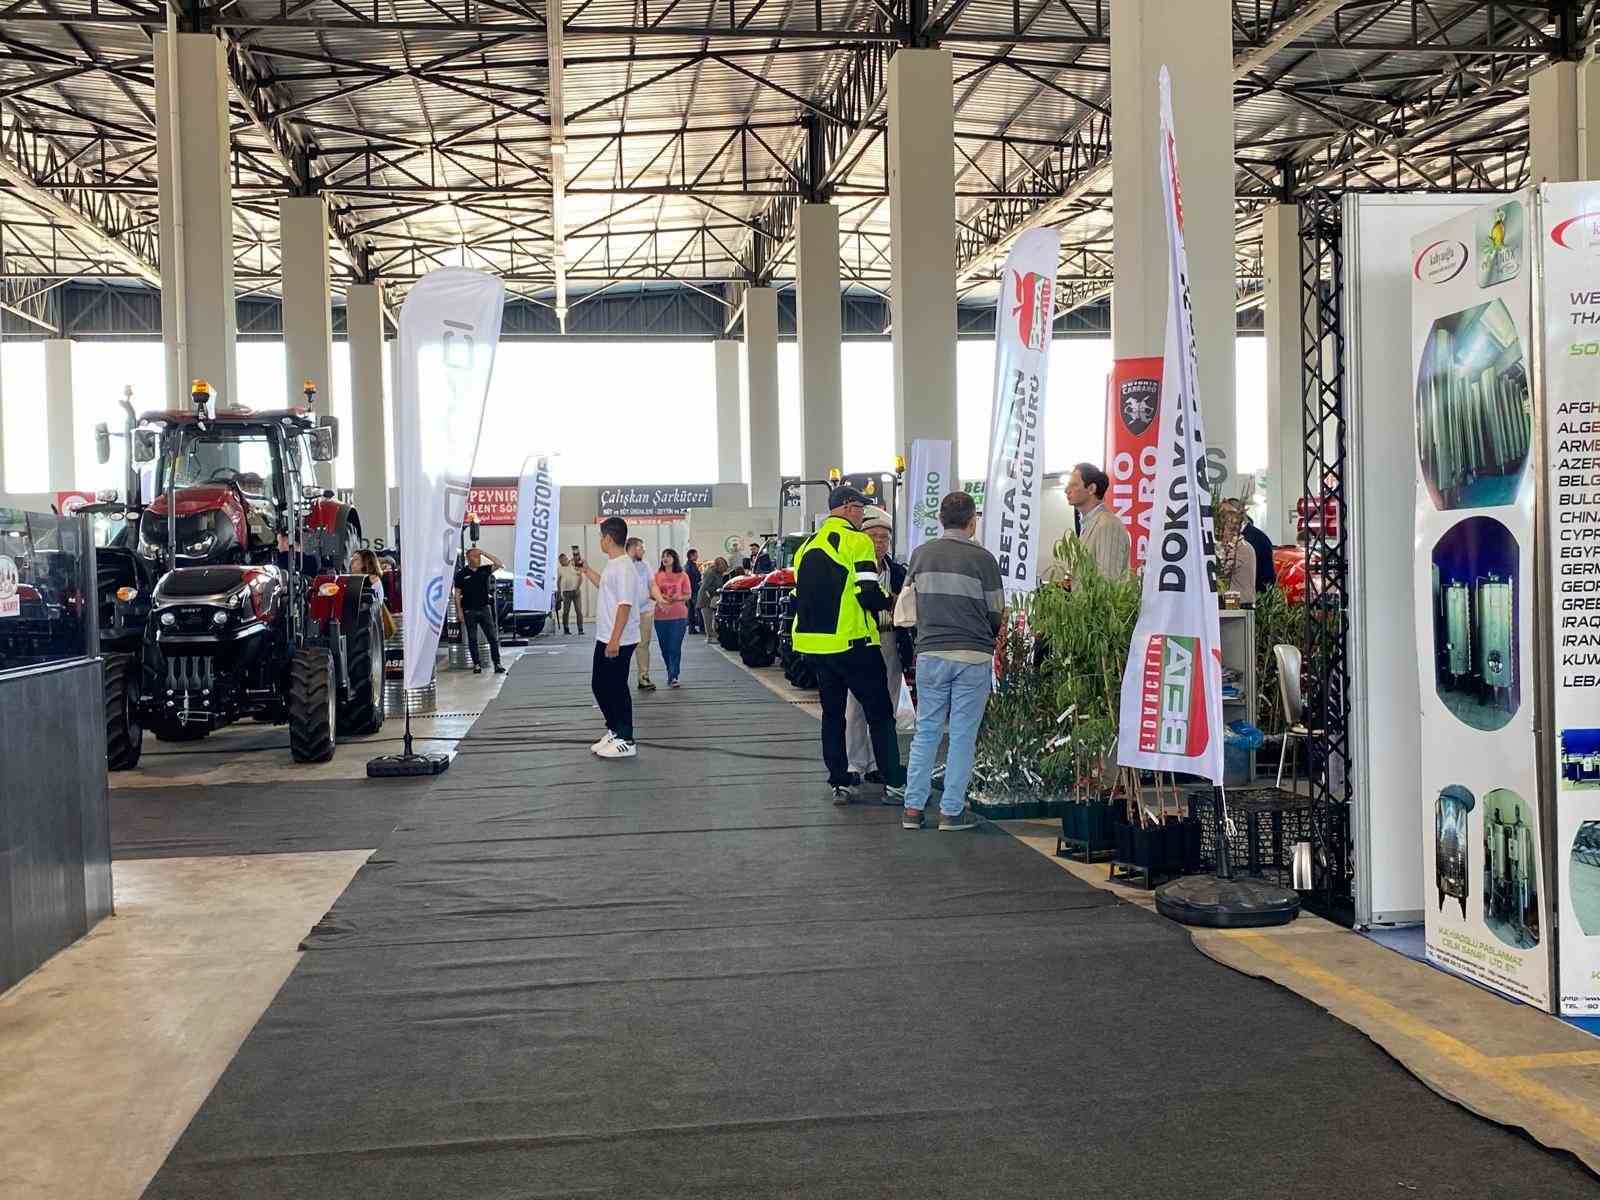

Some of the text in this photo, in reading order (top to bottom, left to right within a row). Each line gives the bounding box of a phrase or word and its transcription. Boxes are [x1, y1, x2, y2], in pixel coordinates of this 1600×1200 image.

[1569, 342, 1600, 356] SO
[600, 487, 710, 507] Çalışkan Şarküteri
[925, 471, 940, 520] AGRO
[1560, 511, 1600, 523] CHIN
[999, 487, 1016, 578] BETA
[1015, 502, 1031, 581] DOKU
[1562, 615, 1600, 629] IRAQ
